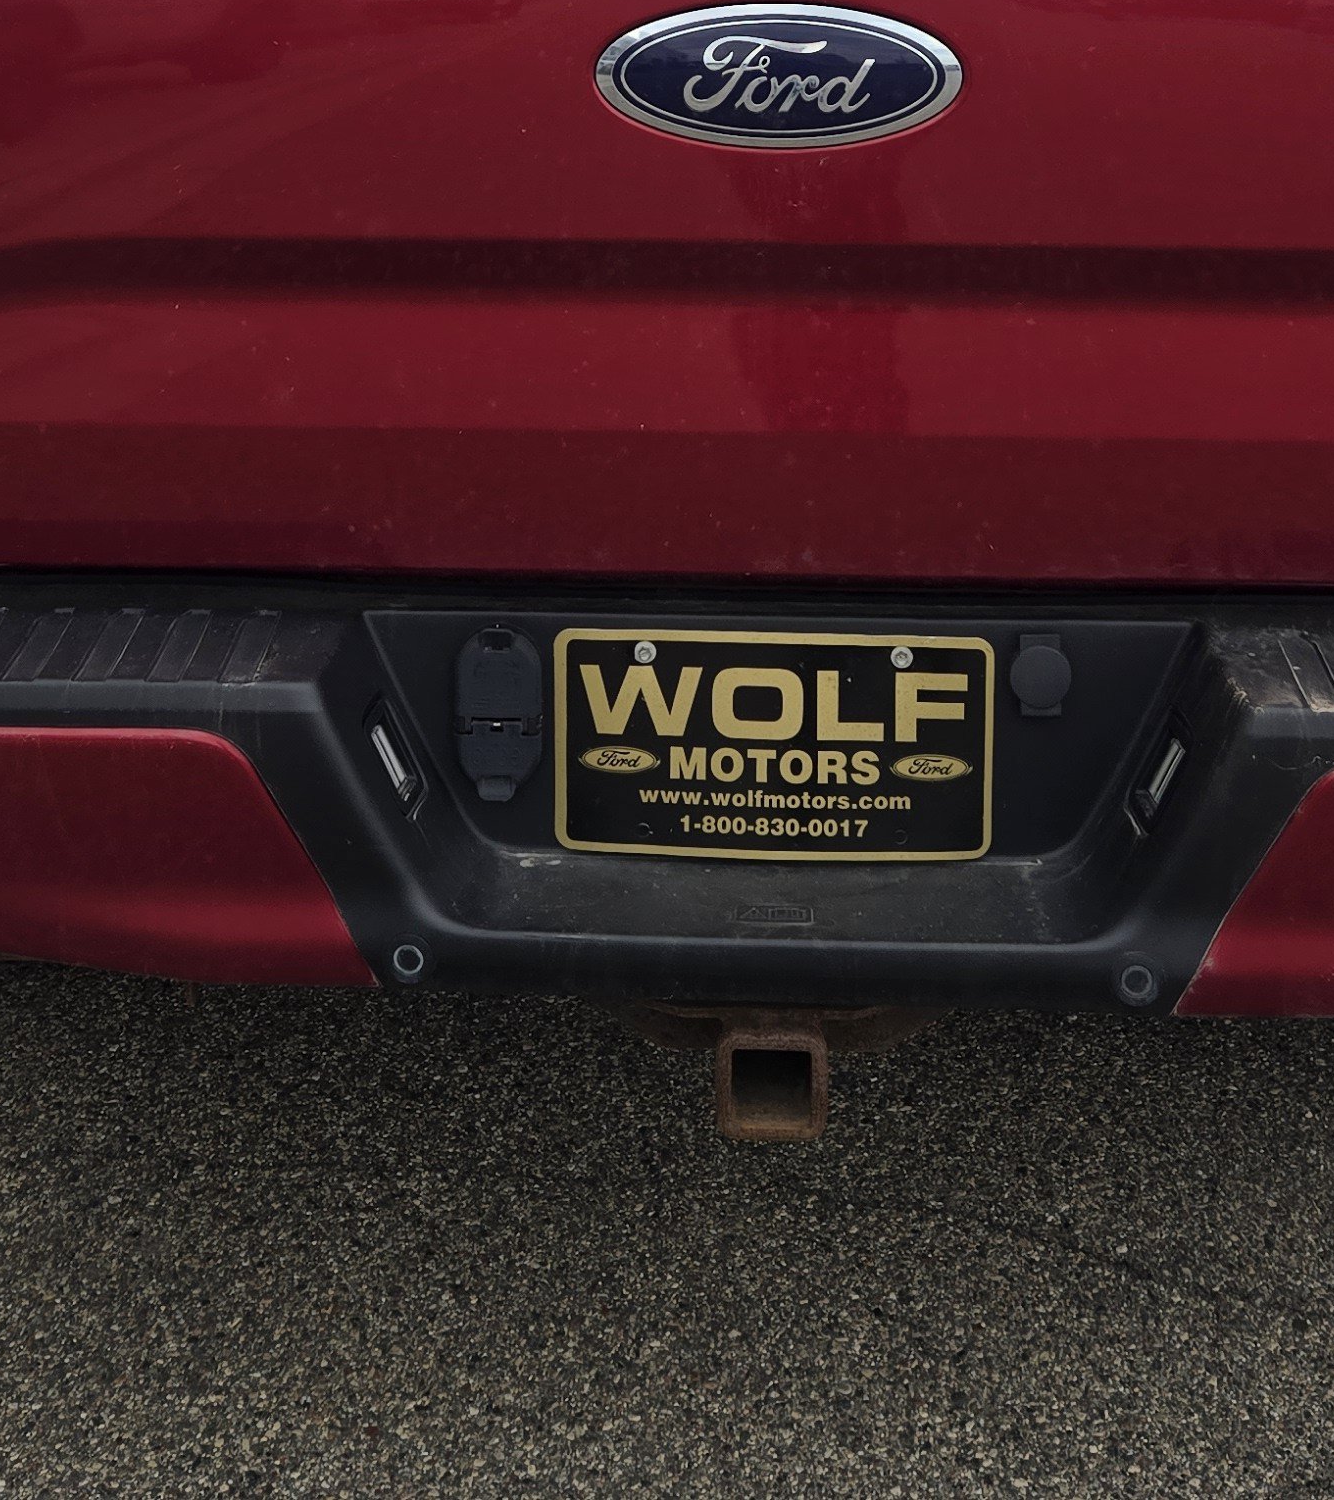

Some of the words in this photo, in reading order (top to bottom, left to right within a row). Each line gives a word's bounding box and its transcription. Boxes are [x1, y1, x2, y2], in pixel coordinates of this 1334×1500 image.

[682, 35, 876, 114] Ford
[578, 663, 969, 743] WOLF
[594, 748, 643, 769] Ford
[668, 746, 882, 786] MOTORS
[906, 757, 955, 777] Ford
[638, 787, 912, 811] www.wolfmotors.com
[679, 815, 869, 839] 1-800-830-0017
